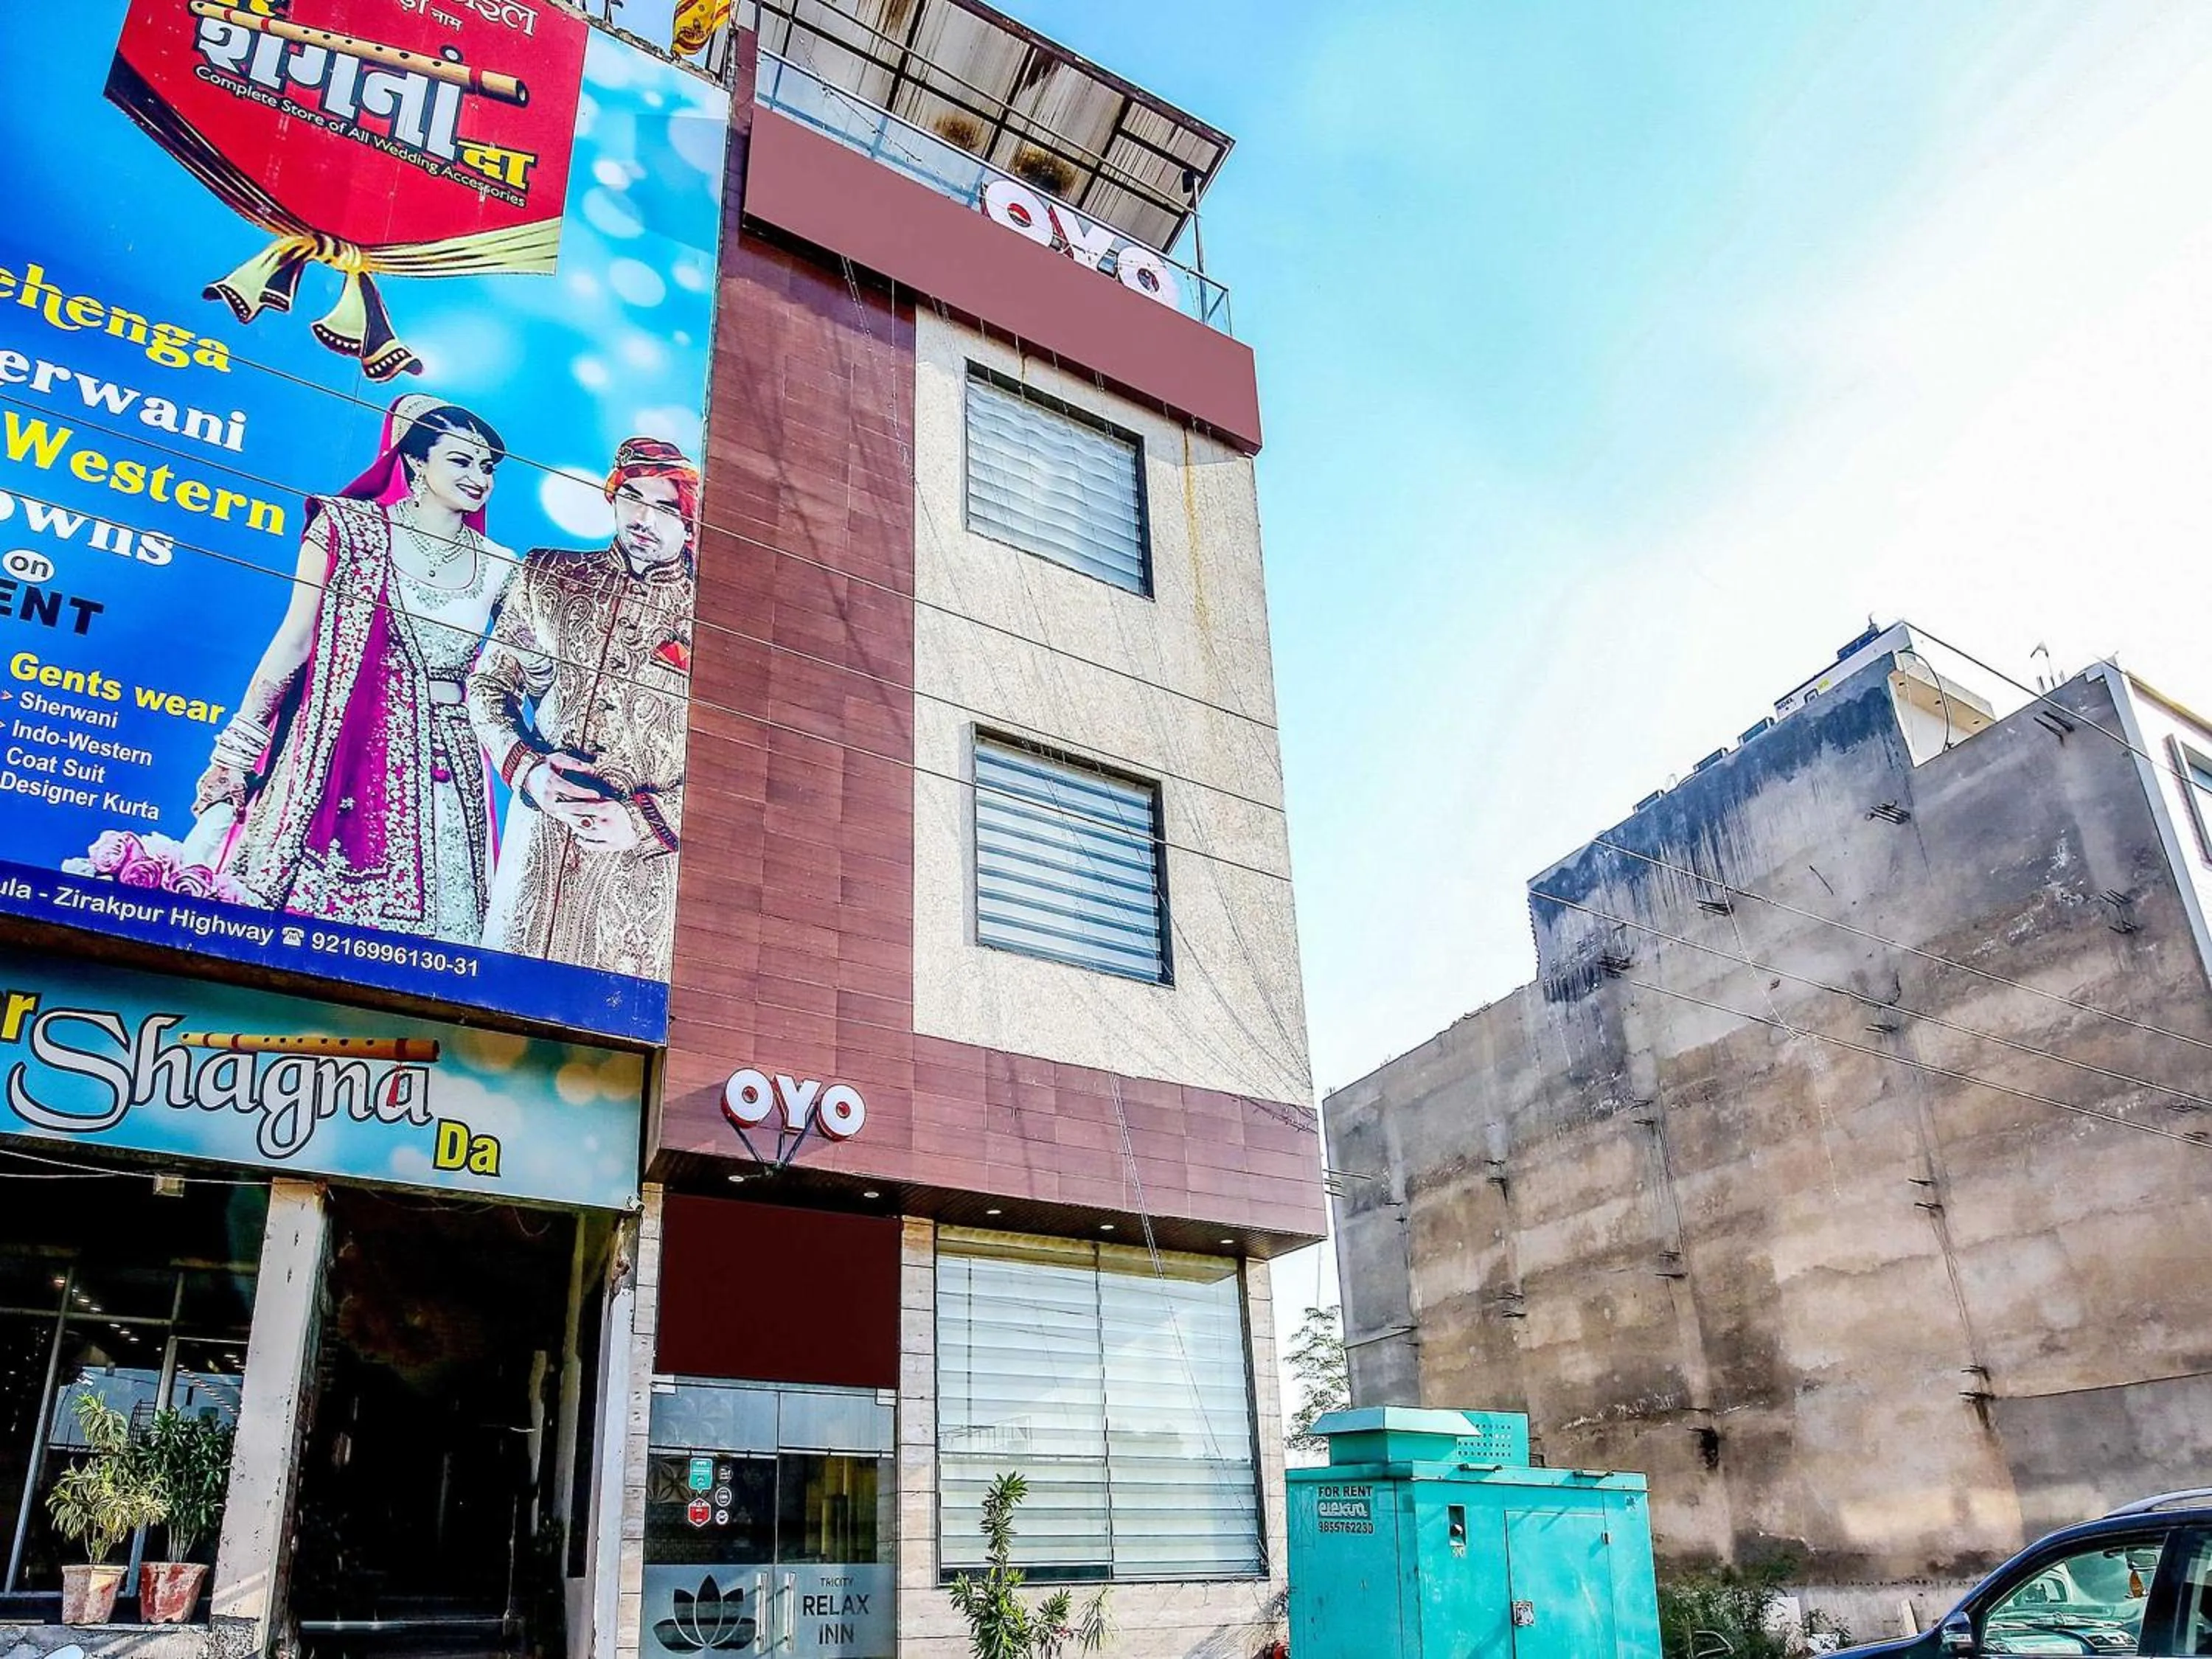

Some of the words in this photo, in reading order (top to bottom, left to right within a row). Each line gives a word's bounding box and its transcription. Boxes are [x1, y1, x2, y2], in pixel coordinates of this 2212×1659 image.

[431, 7, 463, 31] नाम
[195, 66, 277, 108] Complete
[281, 100, 325, 126] Store
[328, 120, 346, 134] of
[348, 127, 369, 144] All
[374, 135, 439, 175] Wedding
[442, 165, 526, 207] Accessories
[981, 179, 1180, 313] OYO
[4, 411, 286, 537] Western
[10, 555, 49, 577] on
[10, 652, 122, 702] Gents
[134, 686, 226, 724] wear
[19, 691, 119, 728] Sherwani
[6, 747, 58, 773] Coat
[63, 759, 106, 783] Suit
[12, 719, 153, 765] Indo-Western
[0, 771, 98, 804] Designer
[102, 792, 160, 820] Kurta
[53, 887, 164, 922] Zirakpur
[170, 907, 274, 946] Highway
[312, 931, 479, 977] 9216996130-31
[6, 1007, 434, 1160] Shagna
[434, 1119, 501, 1177] Da
[722, 1067, 867, 1141] OYO
[1318, 1486, 1340, 1497] FOR
[1343, 1486, 1373, 1497] RENT
[803, 1594, 870, 1615] RELAX
[820, 1577, 854, 1587] TRICITY
[818, 1623, 854, 1644] INN
